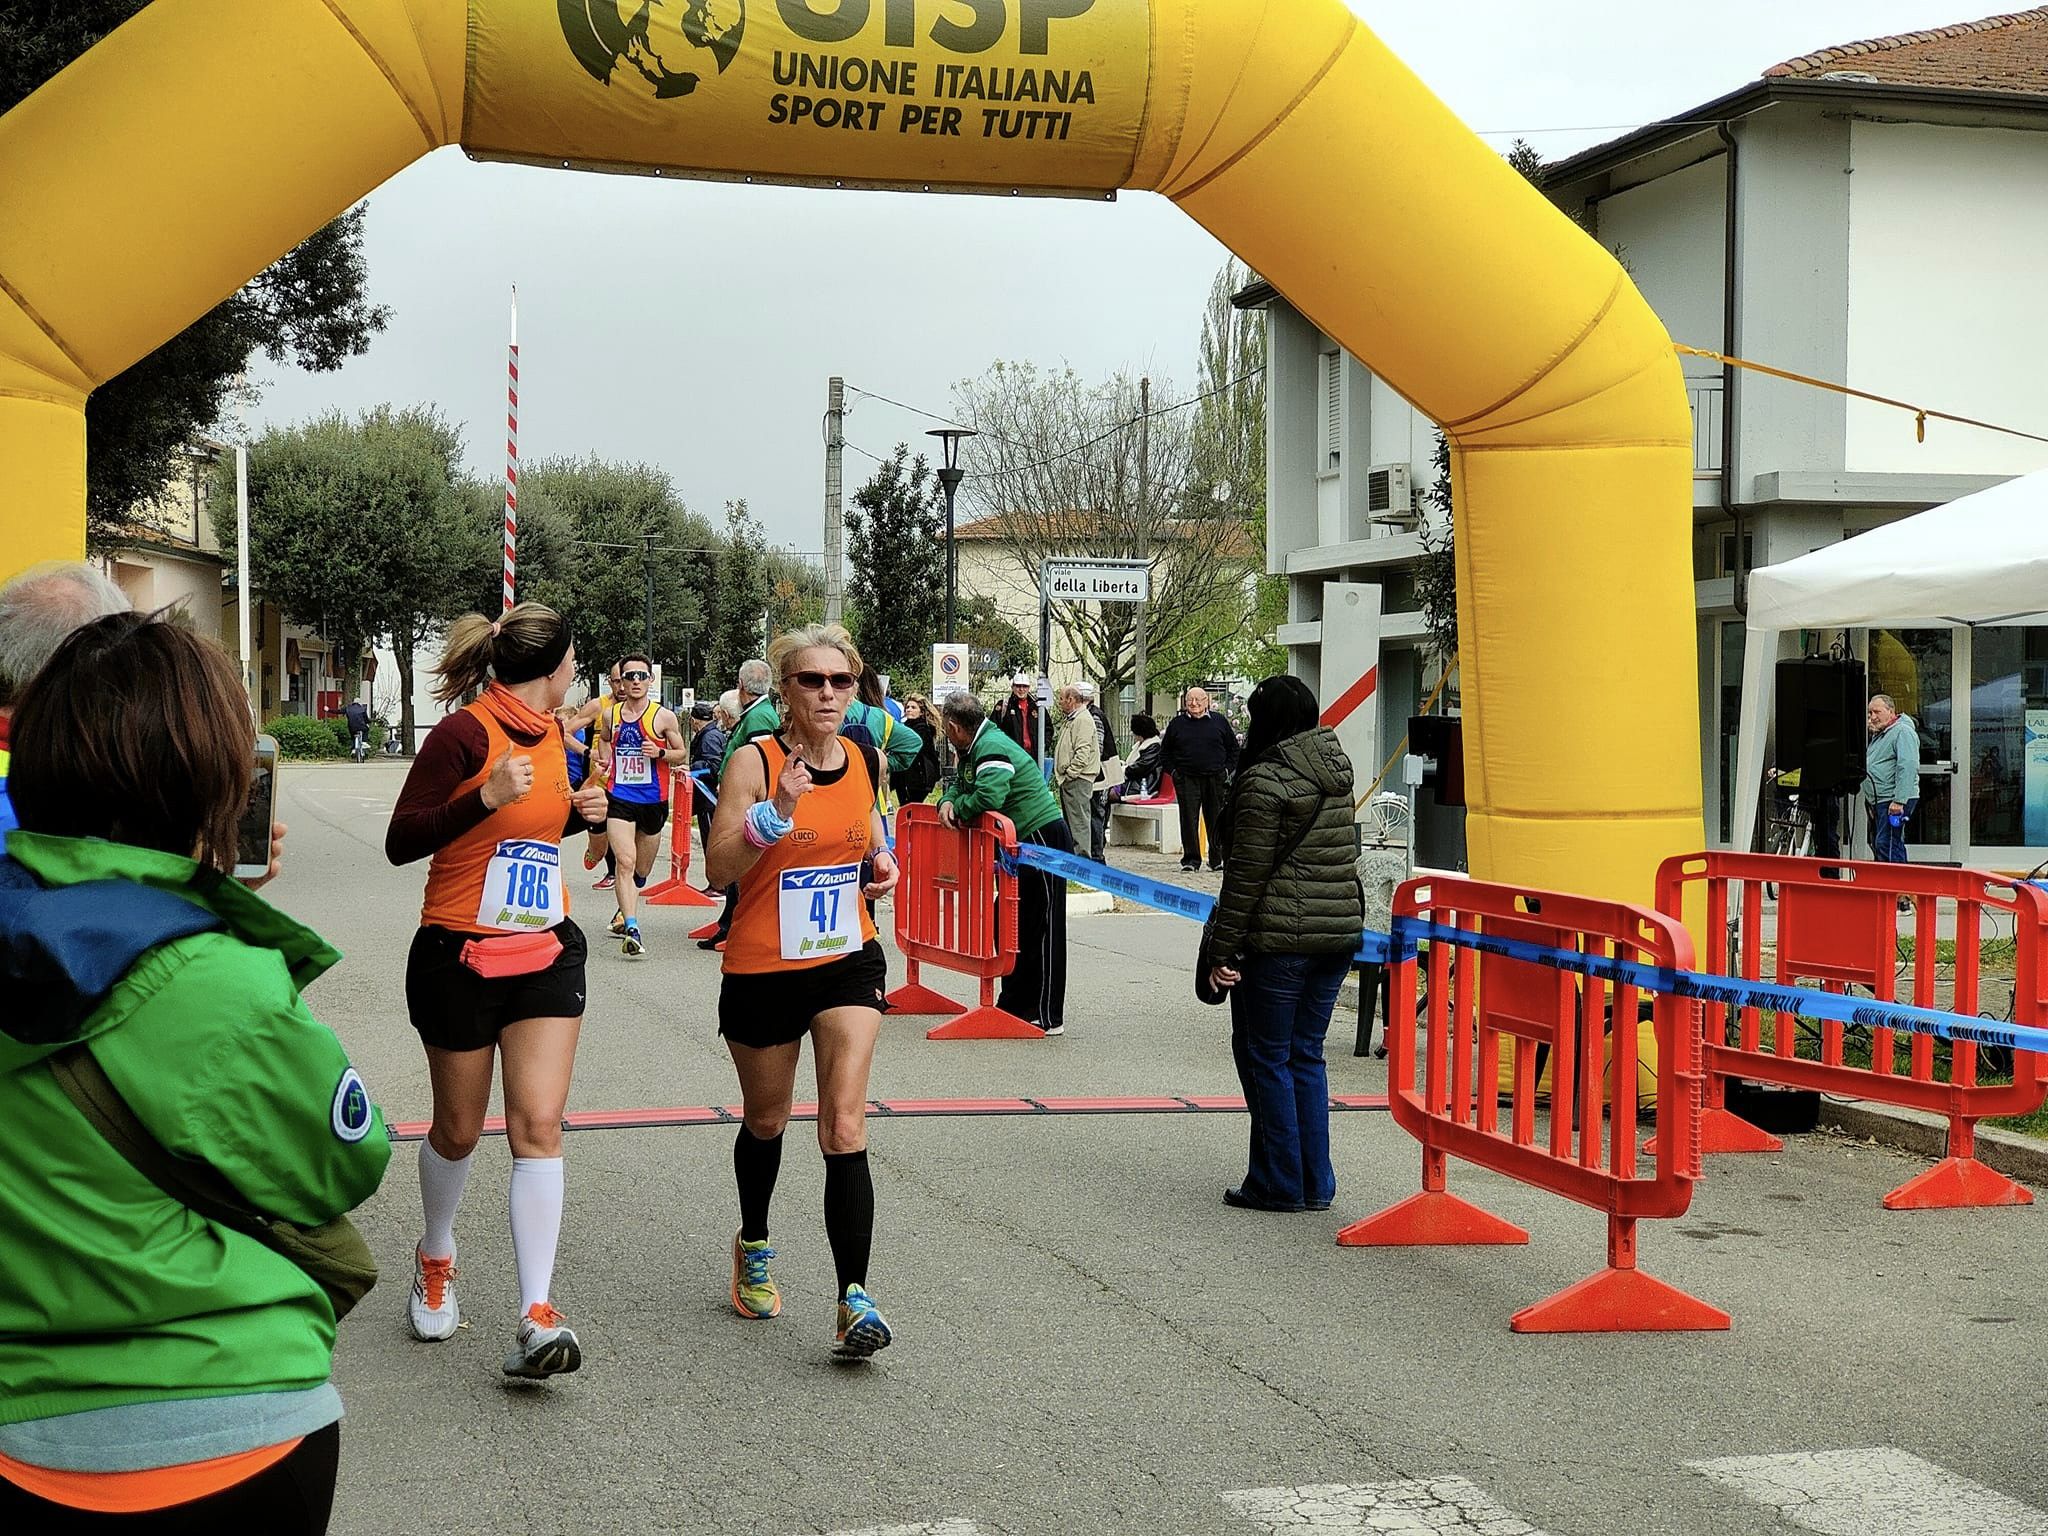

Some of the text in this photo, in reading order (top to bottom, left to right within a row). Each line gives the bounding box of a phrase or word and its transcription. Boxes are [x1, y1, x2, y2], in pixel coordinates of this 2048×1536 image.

[772, 50, 1095, 105] UNIONE ITALIANA
[767, 93, 1072, 140] SPORT PER TUTTI
[1053, 578, 1139, 594] della Liberta
[622, 756, 645, 775] 245
[793, 831, 815, 841] LUCCI
[506, 862, 549, 910] 186
[809, 888, 840, 933] 47
